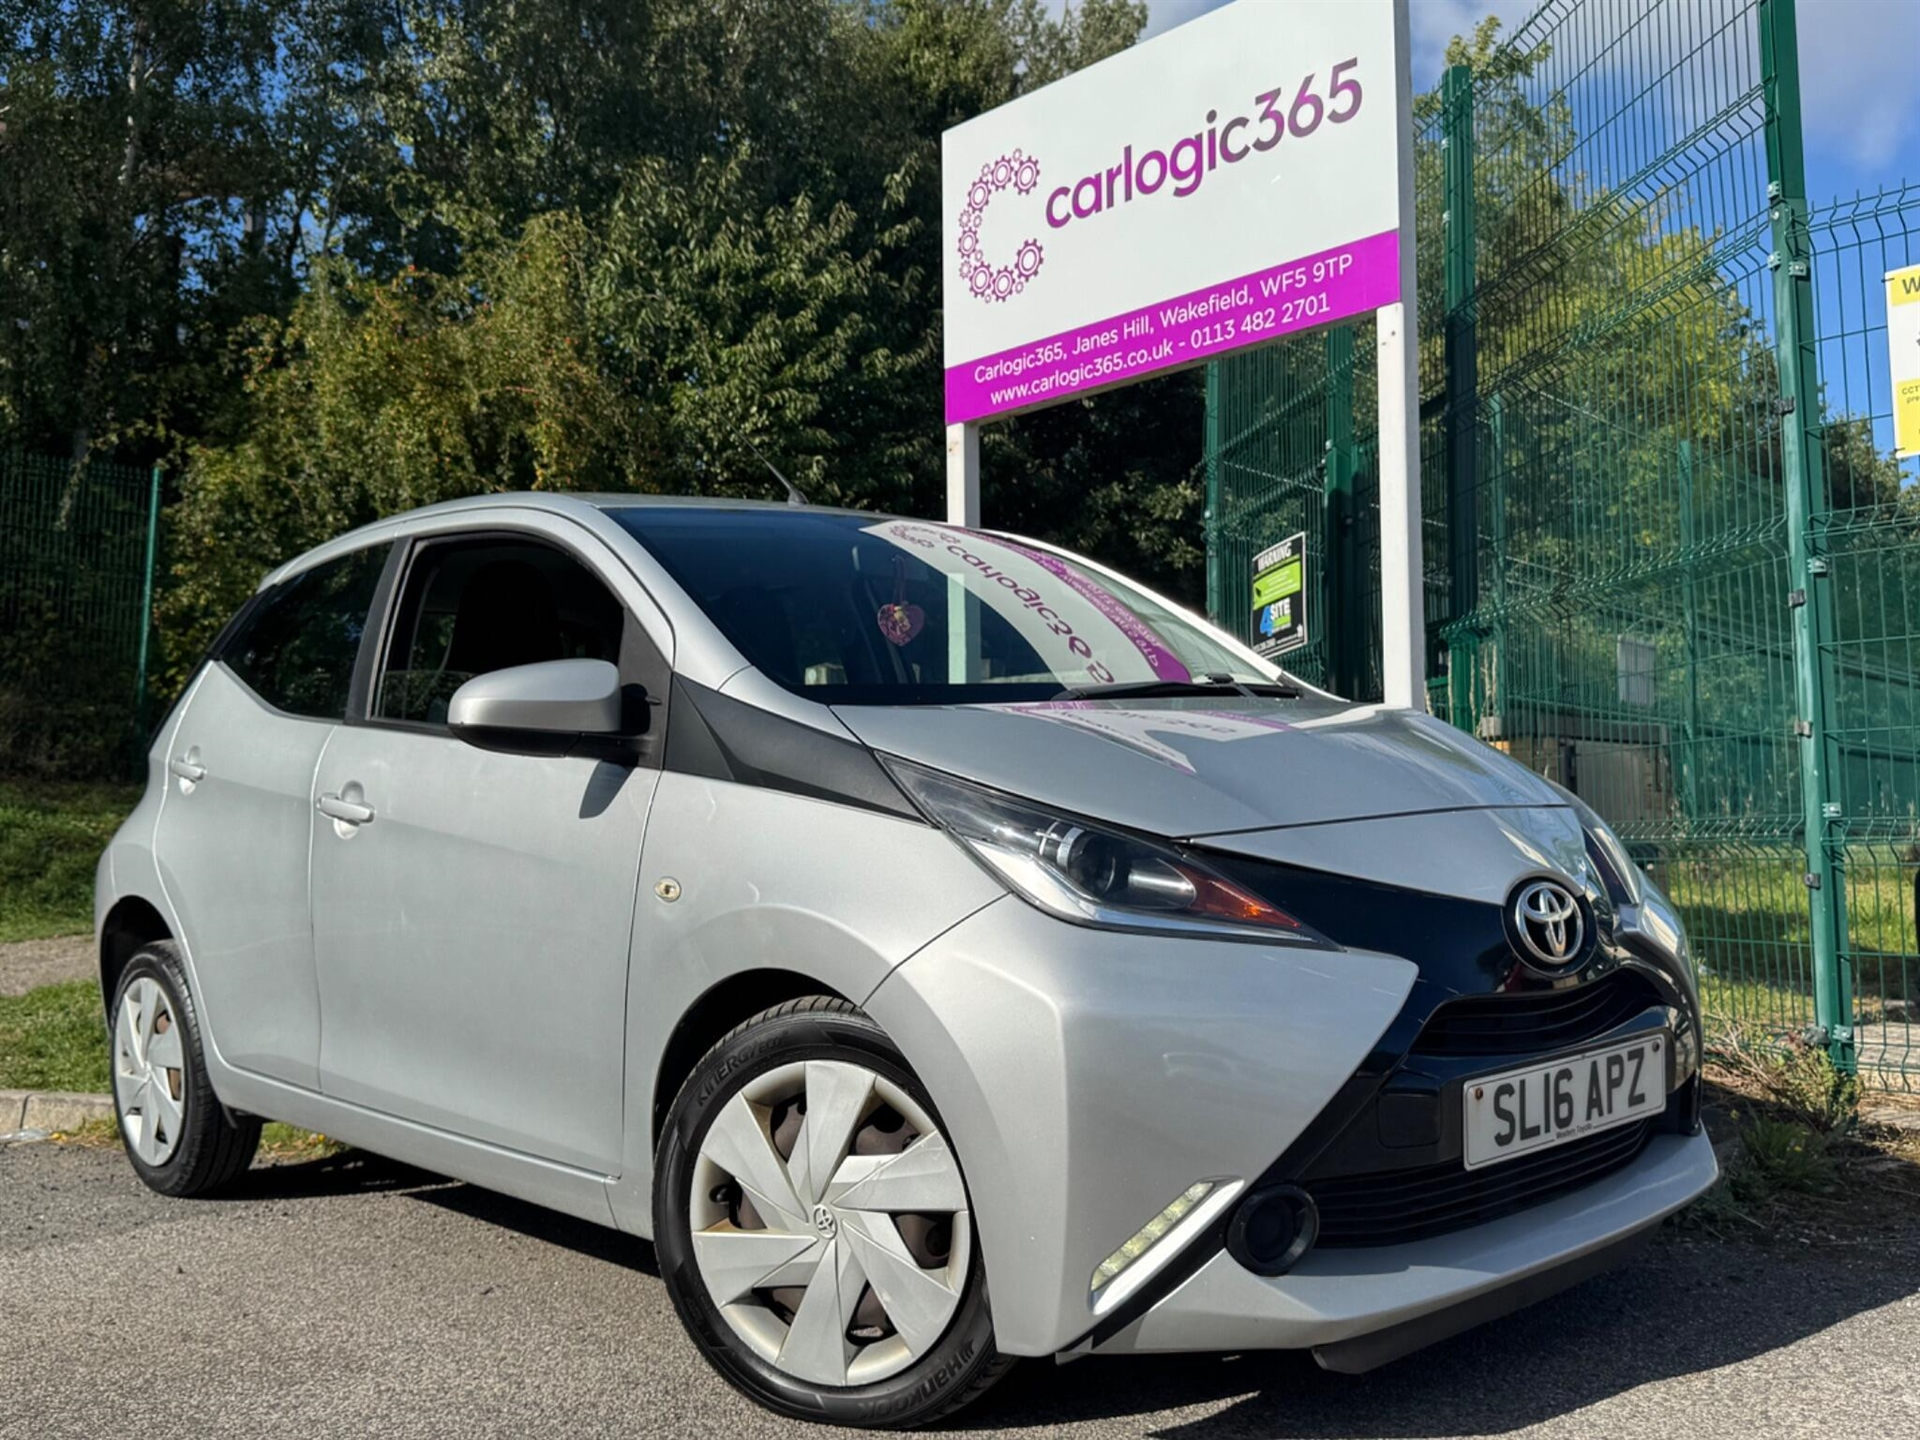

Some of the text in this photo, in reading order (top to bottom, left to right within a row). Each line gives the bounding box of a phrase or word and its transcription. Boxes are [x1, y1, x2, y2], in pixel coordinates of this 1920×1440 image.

[1045, 57, 1363, 229] carlogic365
[974, 253, 1353, 383] Carlogic365, Janes Hill, Wakefield, WF5 9TP
[990, 339, 1173, 405] www.carlogic365.co.uk
[1191, 319, 1235, 349] 0113
[1241, 308, 1275, 333] 482
[1281, 292, 1331, 324] 2701
[1258, 541, 1292, 572] WARNING
[1493, 1047, 1645, 1147] SL16 APZ
